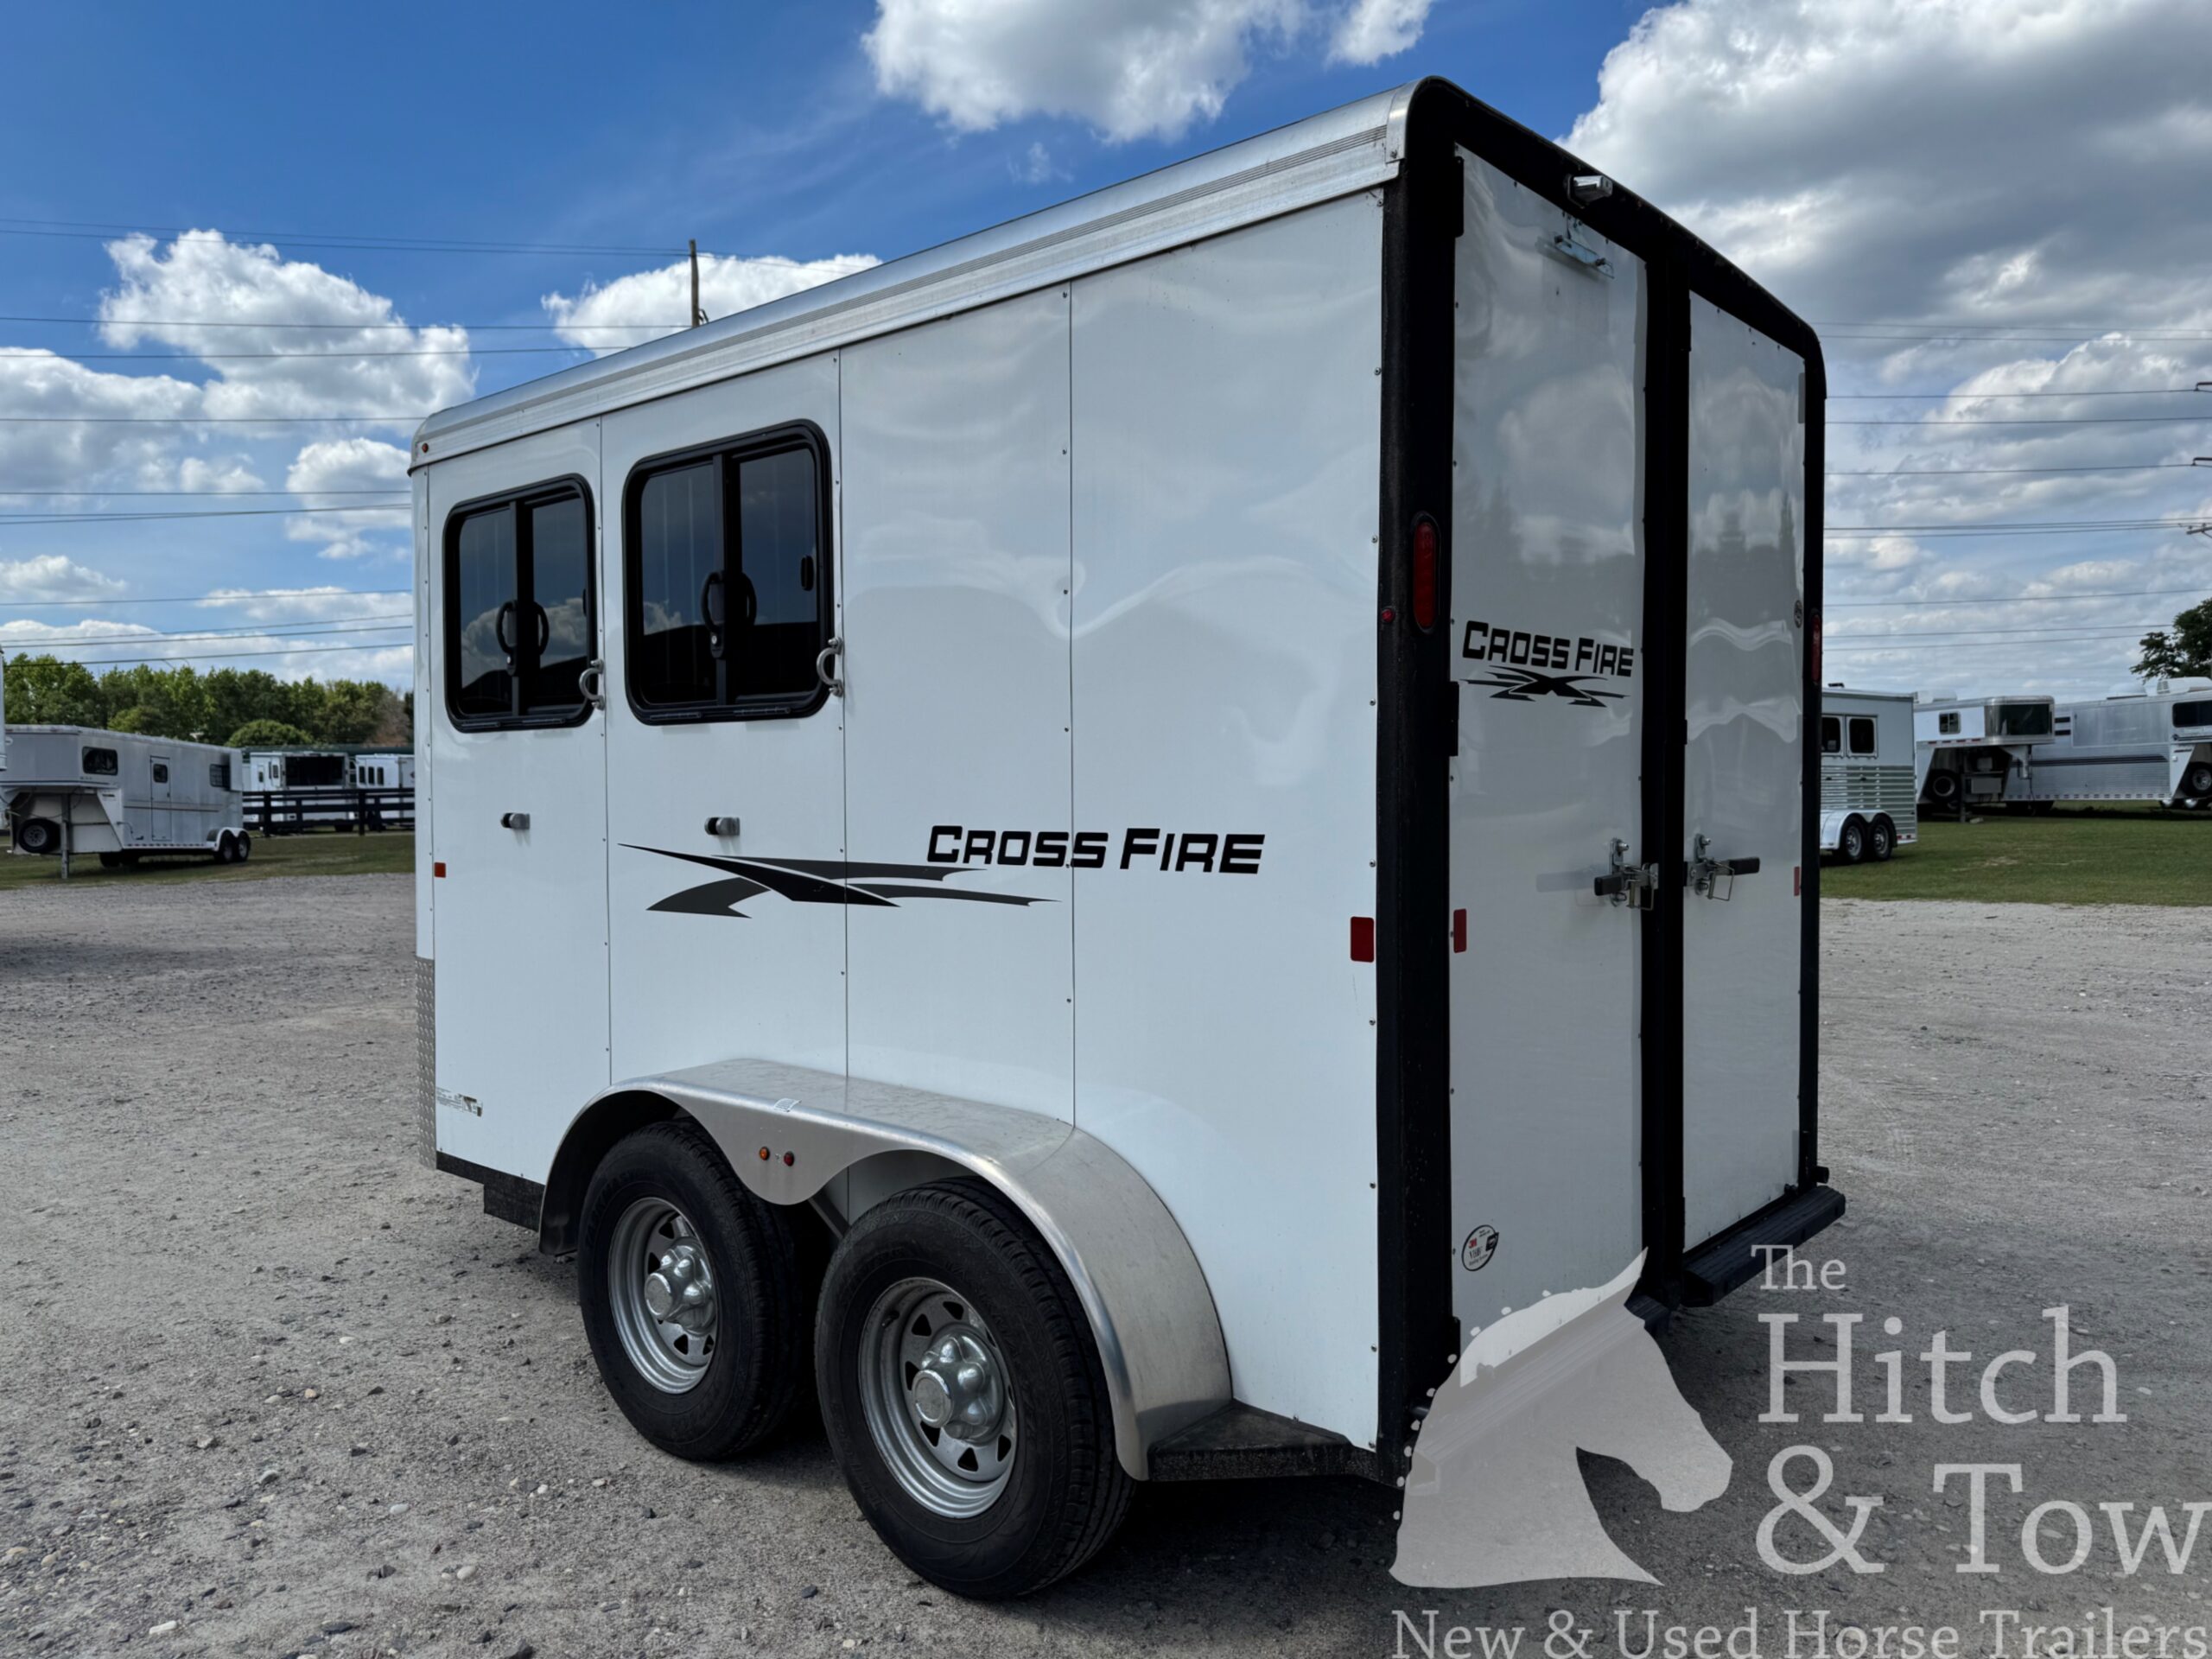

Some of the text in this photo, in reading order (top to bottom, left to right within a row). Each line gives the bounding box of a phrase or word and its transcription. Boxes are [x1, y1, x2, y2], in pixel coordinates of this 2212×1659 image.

[1463, 620, 1634, 677] CROSS FIRE
[927, 825, 1265, 874] CROSS FIRE
